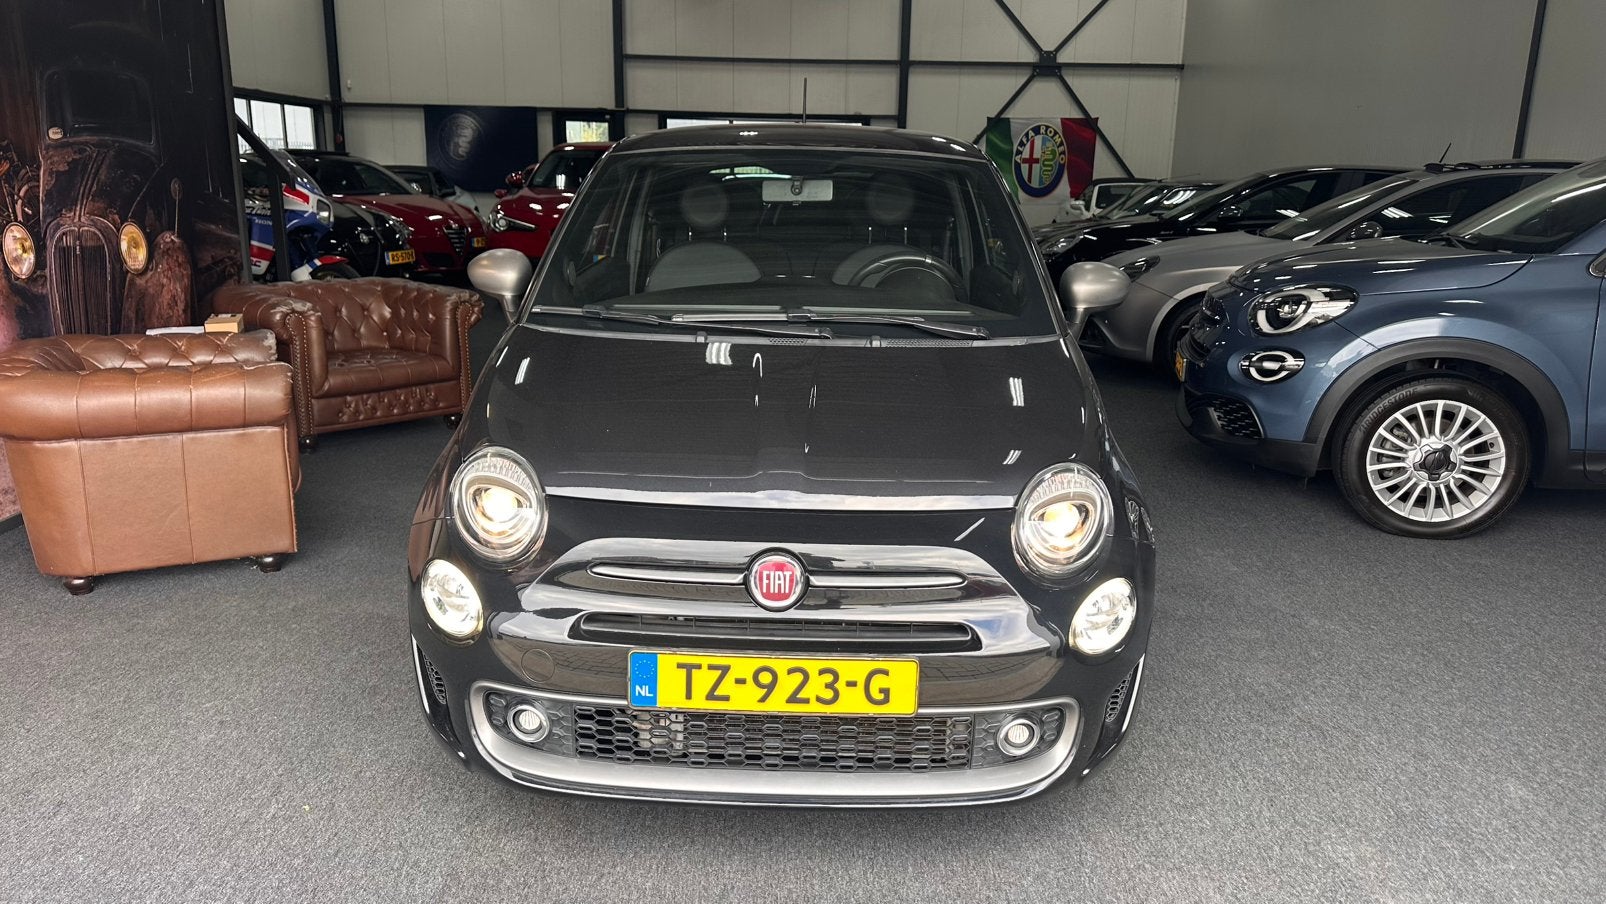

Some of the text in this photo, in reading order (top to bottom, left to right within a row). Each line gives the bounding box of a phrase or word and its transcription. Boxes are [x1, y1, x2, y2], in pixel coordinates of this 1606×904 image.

[1014, 125, 1066, 164] ALFA ROMEO
[762, 570, 792, 594] FIAT
[635, 661, 891, 706] NL TZ-923-G
